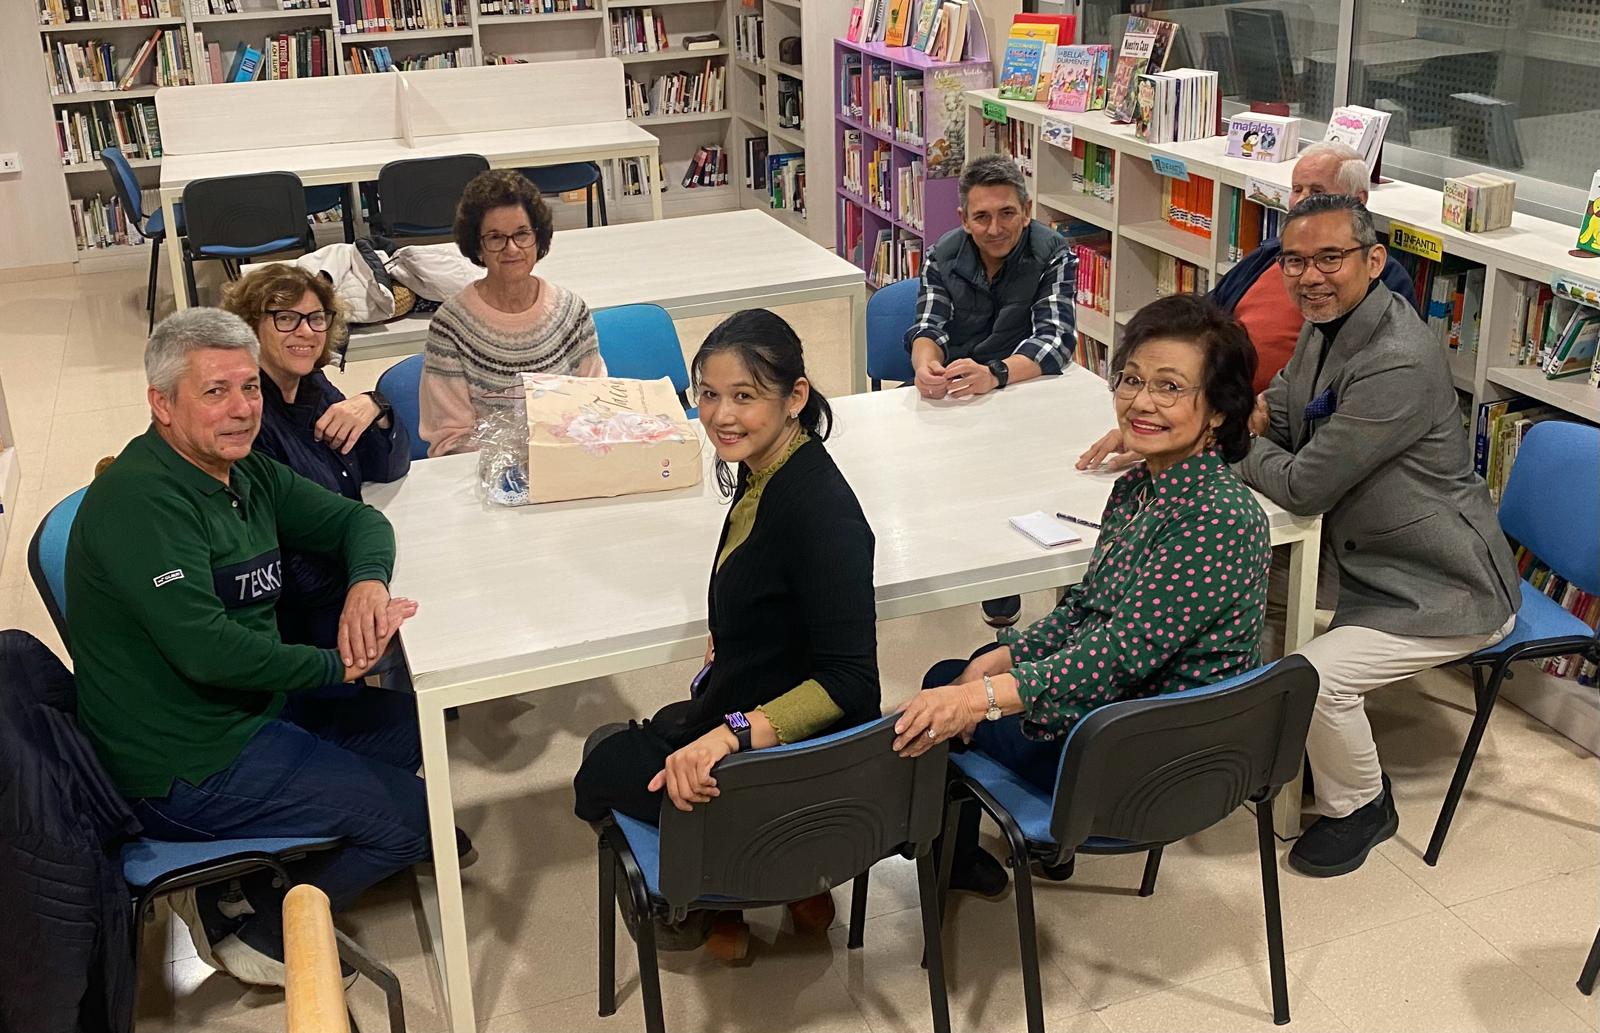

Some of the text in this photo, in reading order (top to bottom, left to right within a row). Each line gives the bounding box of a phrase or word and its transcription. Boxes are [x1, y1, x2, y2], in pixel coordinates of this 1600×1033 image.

[1063, 50, 1082, 58] BELLA
[1056, 57, 1089, 66] DURMIENTE
[280, 63, 287, 72] EL
[1058, 99, 1082, 107] BEAUTY
[1232, 121, 1273, 135] mafalda
[1403, 232, 1438, 253] INFANTIL
